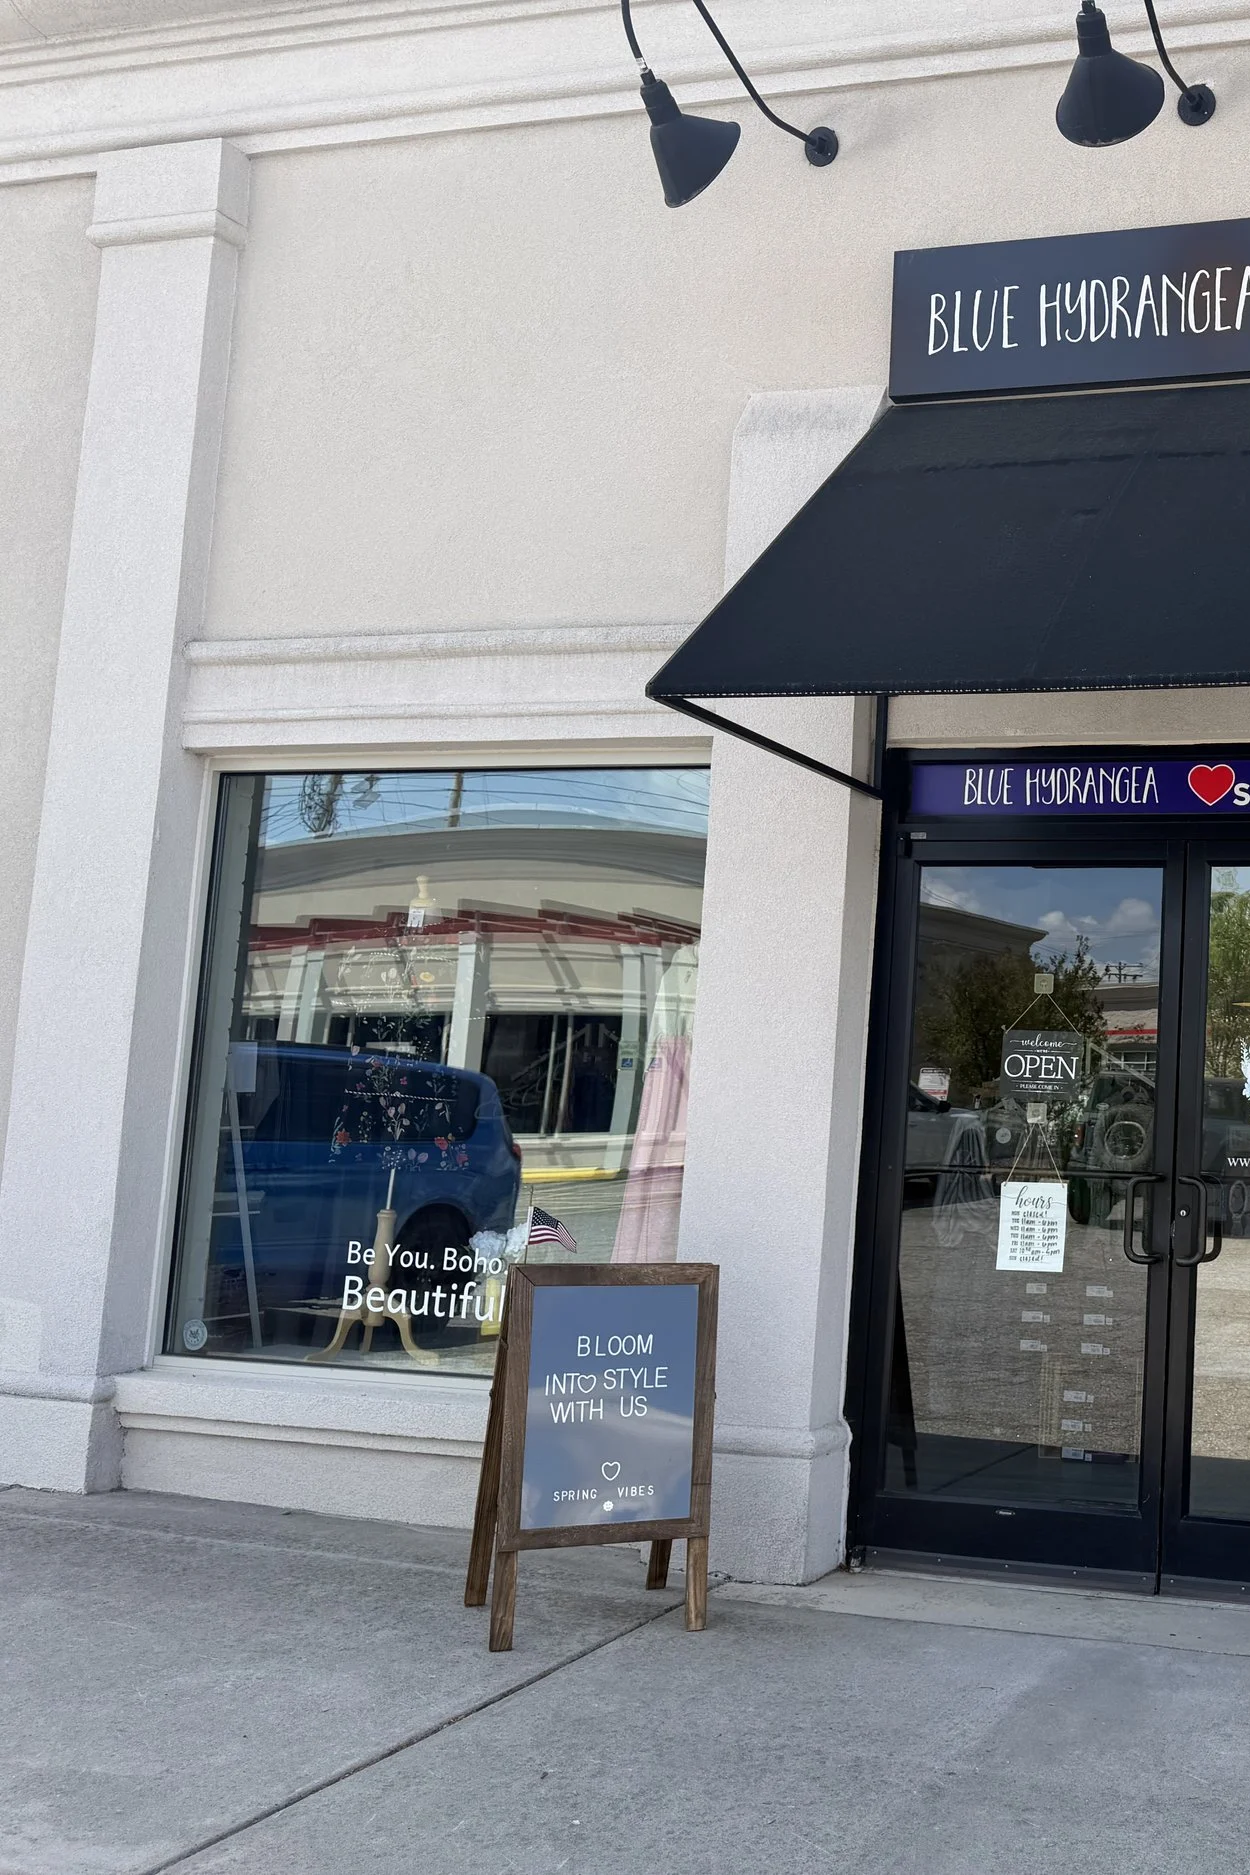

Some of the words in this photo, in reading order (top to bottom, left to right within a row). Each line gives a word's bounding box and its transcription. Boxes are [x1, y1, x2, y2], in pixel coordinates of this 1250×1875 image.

[928, 285, 1020, 356] BLUE
[963, 768, 1015, 806] BLUE
[1025, 766, 1159, 806] HYDRANGEA
[1013, 1033, 1072, 1048] welcome
[1004, 1054, 1080, 1079] OPEN
[1012, 1185, 1058, 1210] hours
[347, 1240, 376, 1265] Be
[385, 1243, 434, 1270] You.
[342, 1275, 507, 1323] Beautiful
[577, 1334, 653, 1357] BLOOM
[603, 1366, 668, 1390] STYLE
[550, 1398, 604, 1424] WITH
[620, 1395, 648, 1417] US
[553, 1488, 598, 1502] SPRING
[617, 1485, 655, 1498] VIBES
